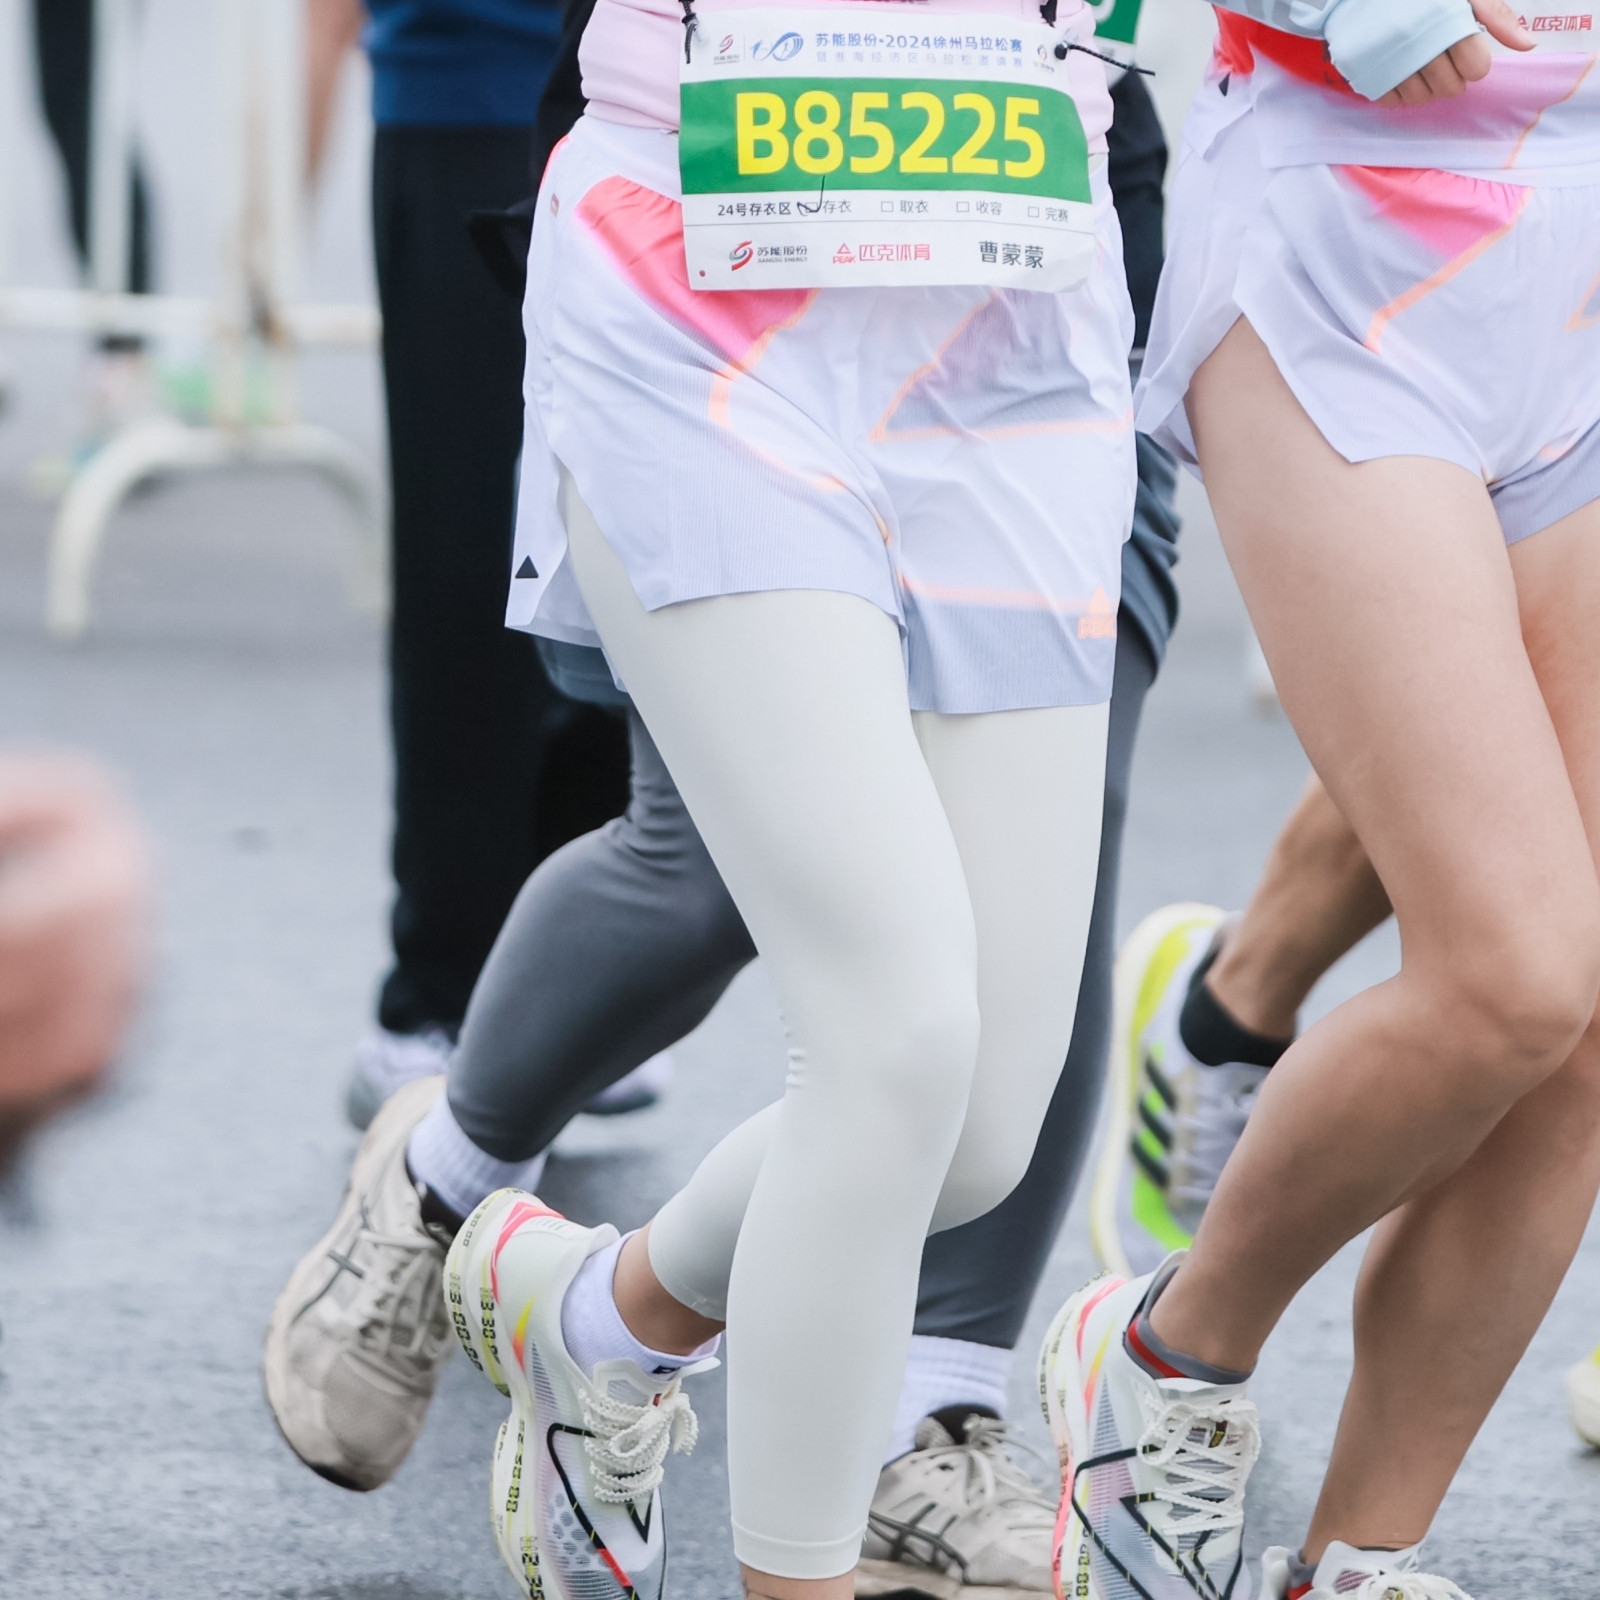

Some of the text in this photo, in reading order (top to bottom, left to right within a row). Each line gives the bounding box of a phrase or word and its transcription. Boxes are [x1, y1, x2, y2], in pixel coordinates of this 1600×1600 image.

[1531, 14, 1594, 32] 匹克体育
[736, 90, 1046, 179] B85225
[717, 199, 1070, 223] 24号存衣区 存衣 取衣 收容 完赛
[757, 245, 808, 257] 苏能股份
[858, 243, 931, 262] 匹克体育
[978, 240, 1045, 270] 曹蒙蒙
